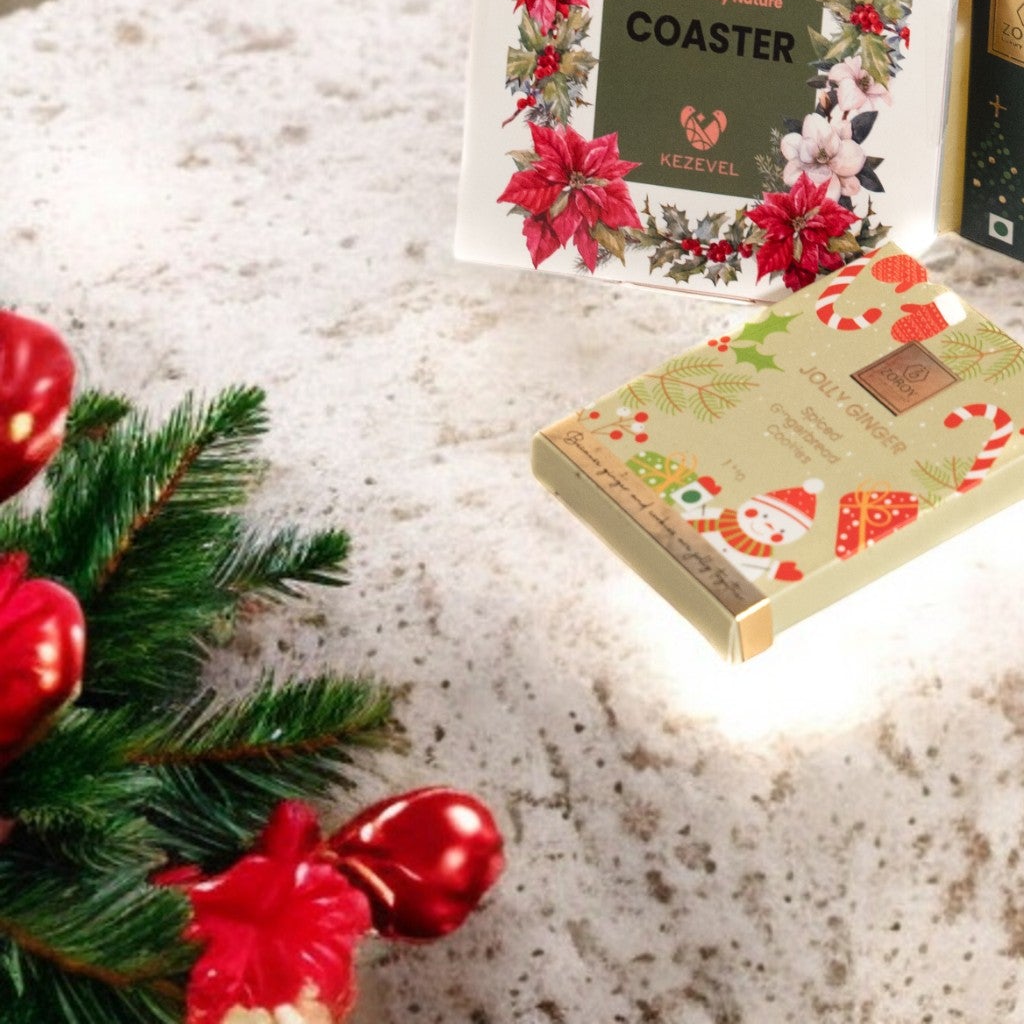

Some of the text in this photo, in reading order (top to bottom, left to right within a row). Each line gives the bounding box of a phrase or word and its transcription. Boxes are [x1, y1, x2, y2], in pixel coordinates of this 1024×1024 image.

[626, 11, 795, 63] COASTER
[660, 152, 740, 176] KEZEVEL
[799, 366, 851, 402] JOLLY
[845, 403, 908, 455] GINGER
[801, 406, 843, 442] Spiced
